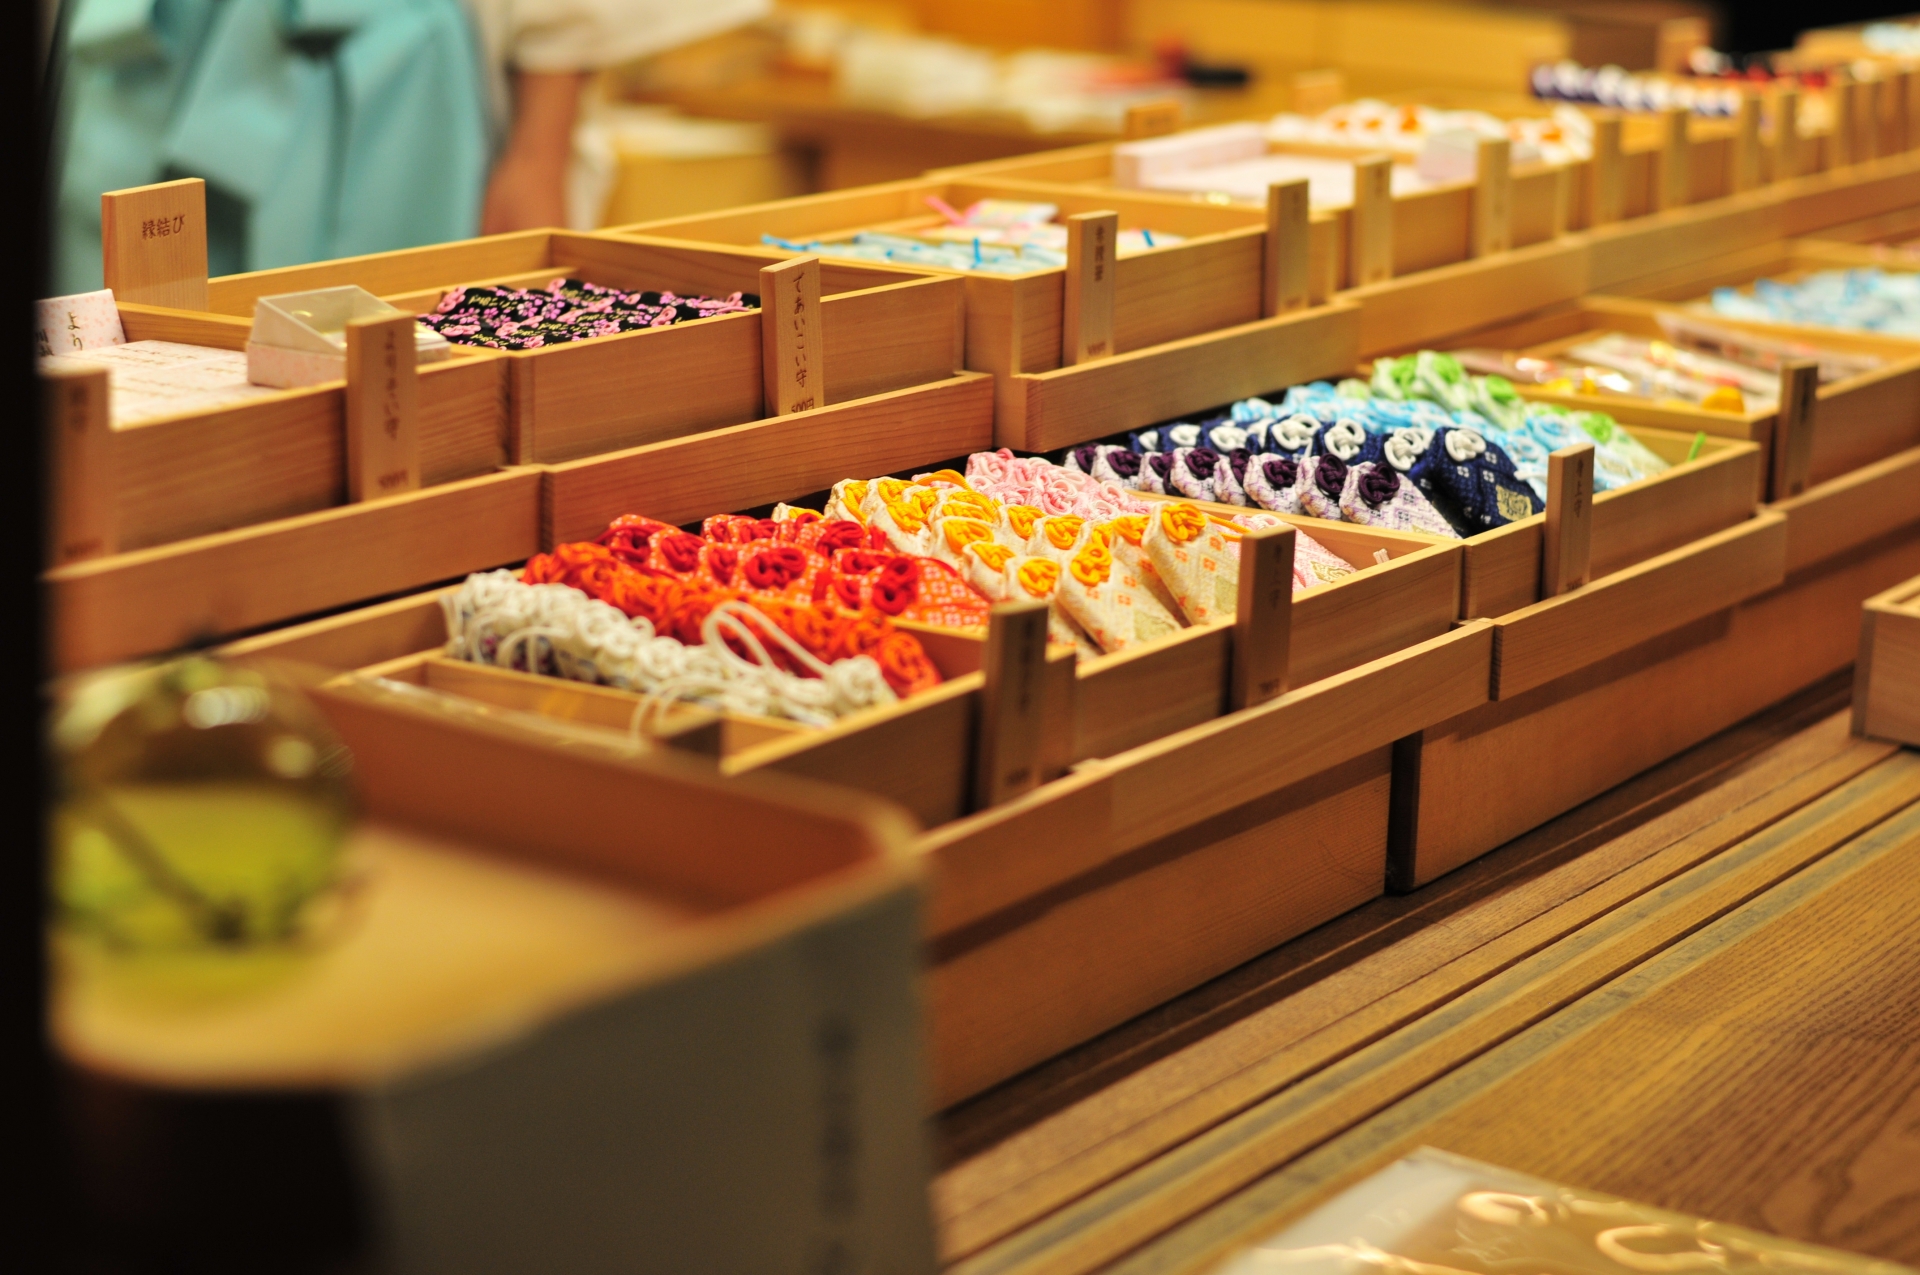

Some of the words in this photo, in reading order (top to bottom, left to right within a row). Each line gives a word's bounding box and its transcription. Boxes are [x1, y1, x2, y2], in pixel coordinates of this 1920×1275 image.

[142, 214, 185, 240] 縁結び
[790, 398, 814, 414] 500円
